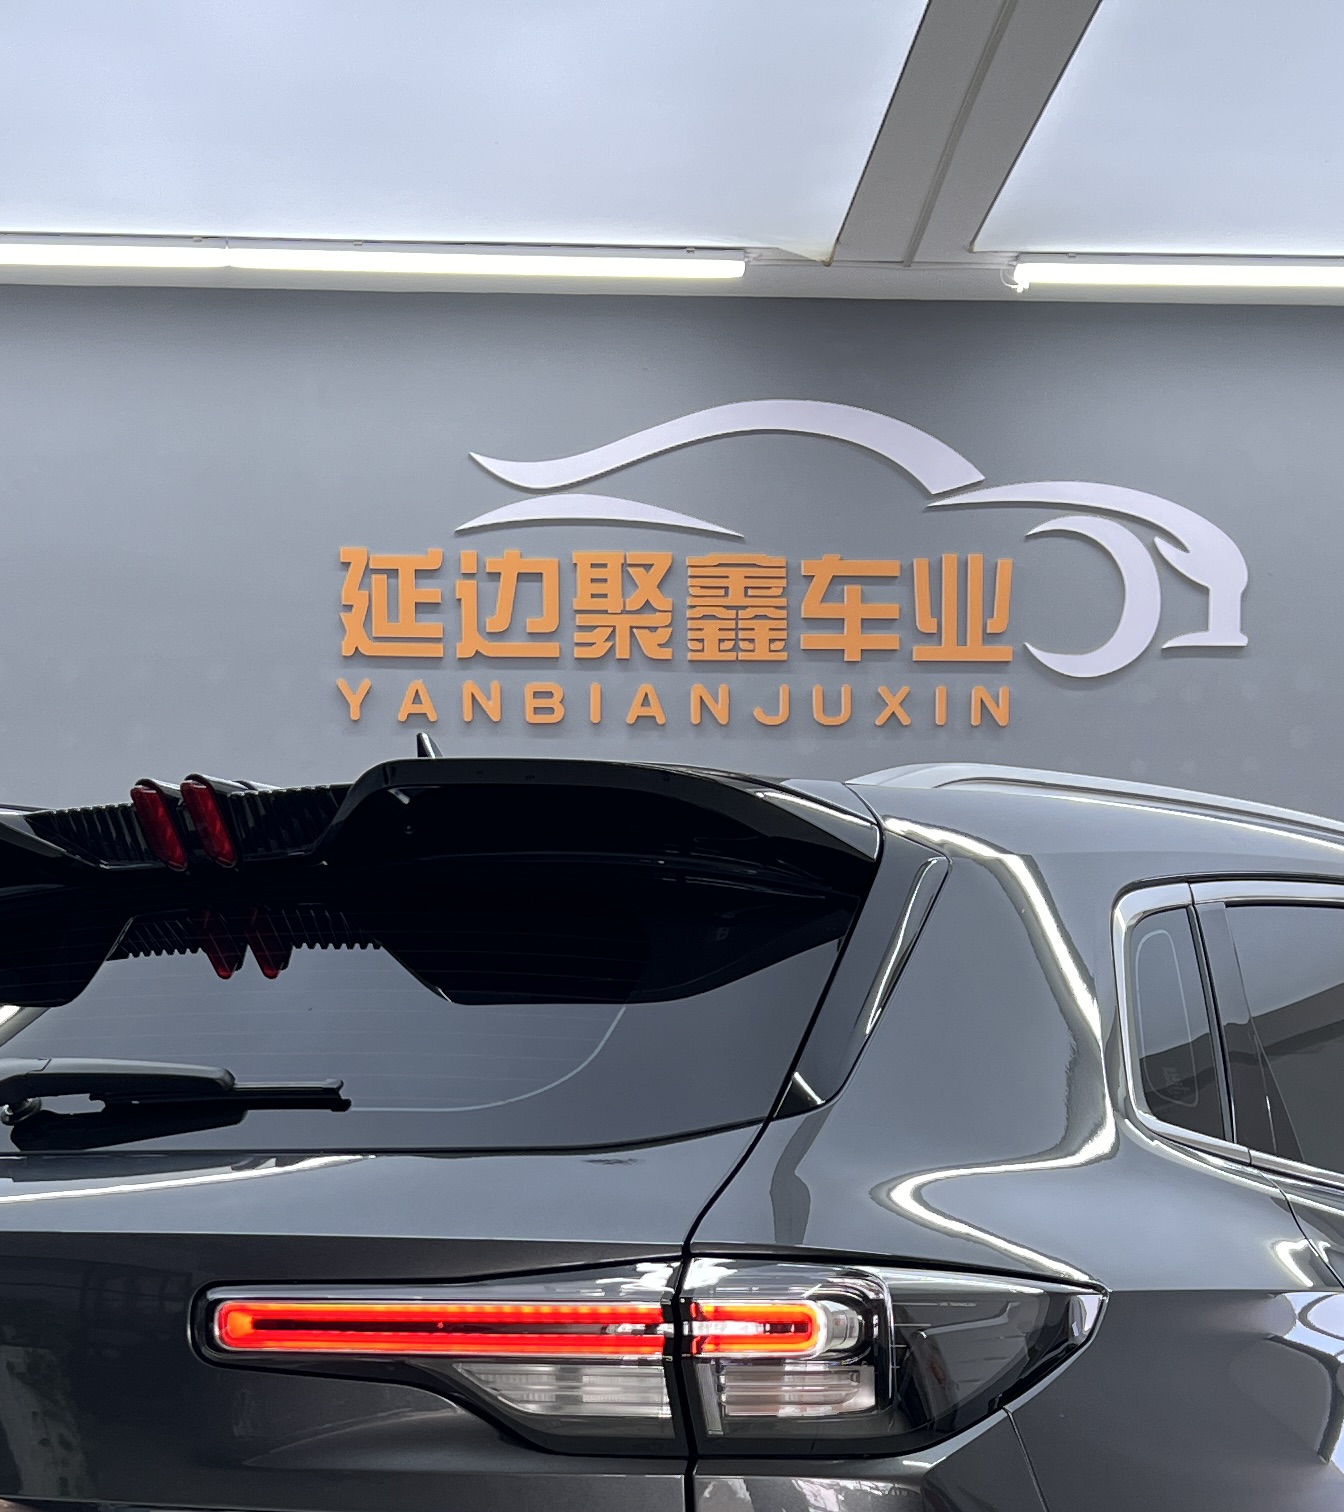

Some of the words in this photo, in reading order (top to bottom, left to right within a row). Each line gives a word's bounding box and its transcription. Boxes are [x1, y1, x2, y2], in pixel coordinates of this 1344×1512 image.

[340, 546, 1014, 663] 延边聚鑫车业
[336, 678, 1012, 727] YANBIANJUXIN
